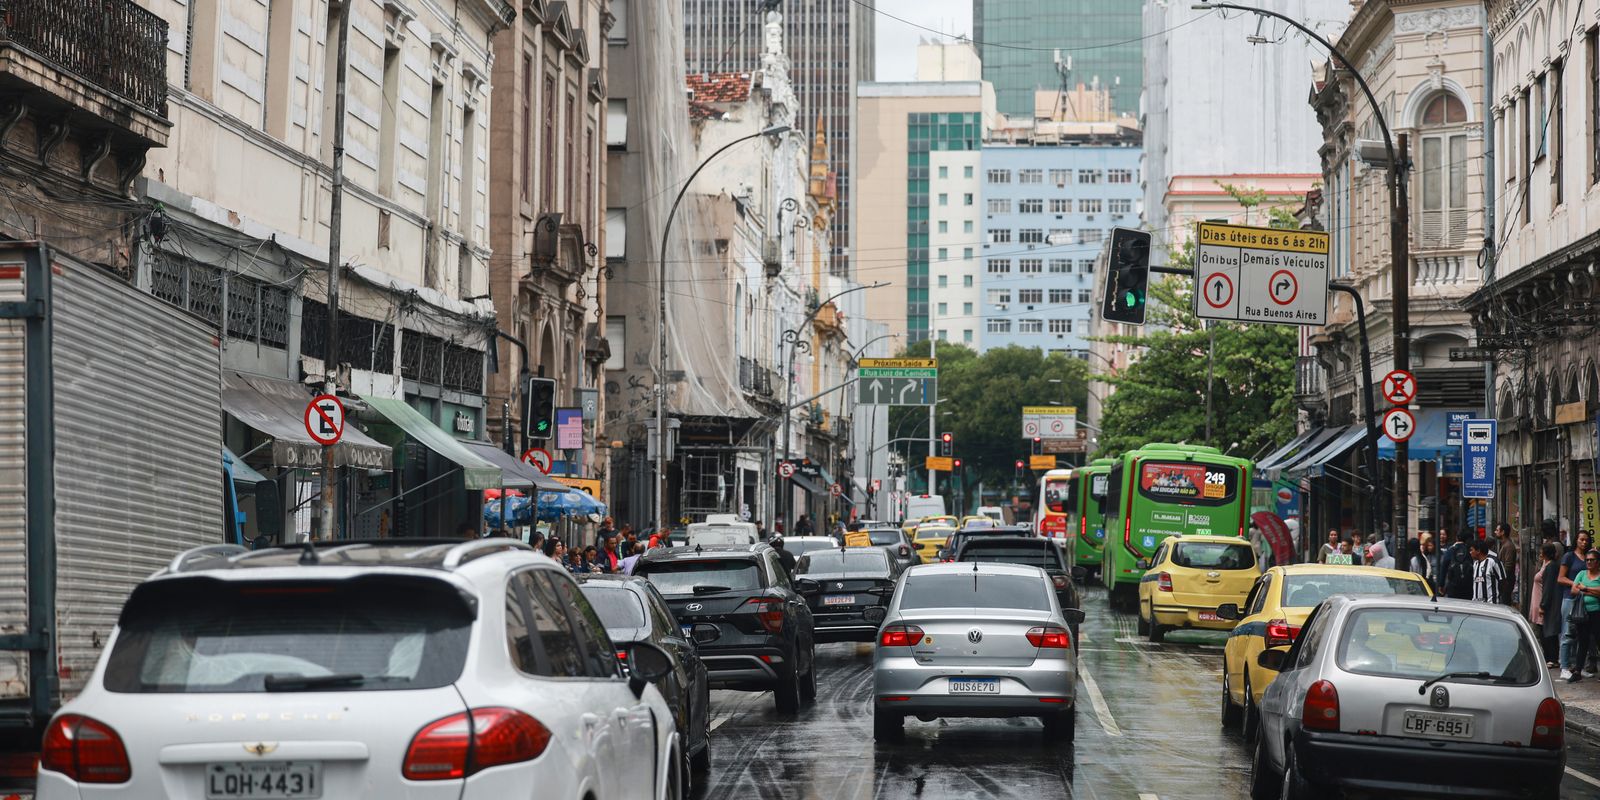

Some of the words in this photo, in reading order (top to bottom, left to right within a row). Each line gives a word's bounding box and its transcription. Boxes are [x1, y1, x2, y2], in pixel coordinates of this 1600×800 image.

[1203, 228, 1226, 241] Dias
[1230, 230, 1257, 244] úteis
[1261, 234, 1279, 246] das
[1282, 235, 1289, 246] 6
[1308, 237, 1325, 249] 21h
[1201, 251, 1238, 266] Ônibus
[1243, 252, 1280, 266] Demais
[1283, 253, 1325, 269] Veículos
[1245, 306, 1261, 316] Rua
[1264, 307, 1293, 319] Buenos
[1296, 310, 1317, 320] Aires
[873, 359, 902, 367] Próxima
[864, 369, 878, 377] Rua
[879, 369, 894, 377] Luiz
[895, 369, 903, 377] de
[1204, 471, 1226, 485] 249
[1327, 553, 1352, 565] TAXI
[953, 682, 995, 692] QUS6E70
